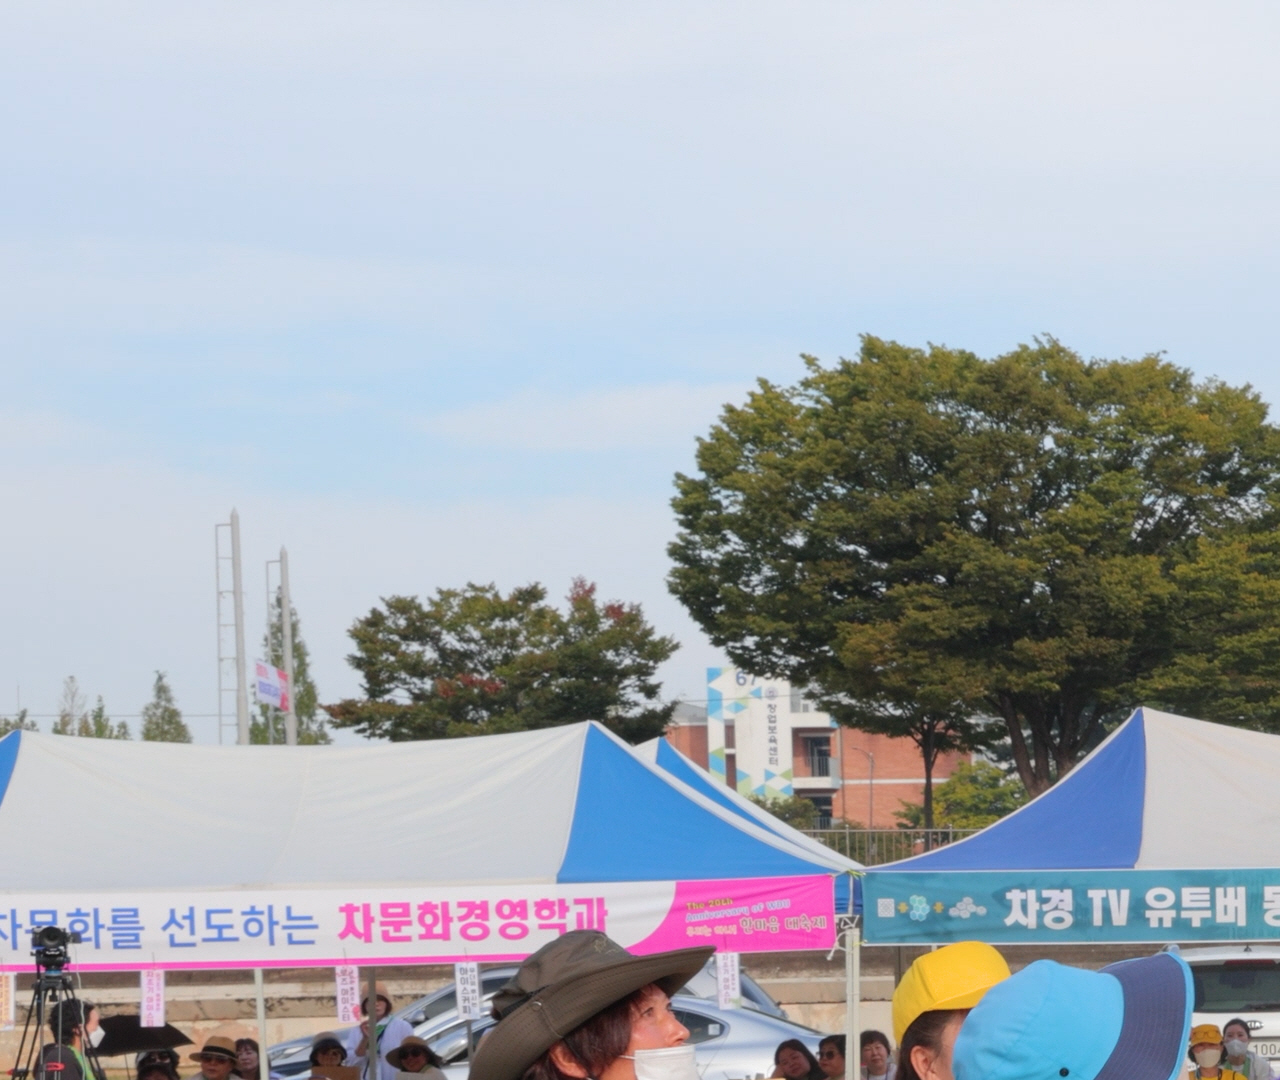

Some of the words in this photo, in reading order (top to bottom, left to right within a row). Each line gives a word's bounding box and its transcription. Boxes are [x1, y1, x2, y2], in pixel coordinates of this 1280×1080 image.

[767, 704, 779, 767] 창업보육센터
[685, 906, 749, 923] Anniversary
[751, 903, 764, 913] of
[686, 902, 705, 911] The
[708, 898, 733, 908] 20th
[1004, 888, 1074, 931] 차경
[1087, 888, 1131, 927] TV
[1145, 887, 1247, 930] 유투버
[161, 905, 319, 948] 선도하는
[338, 897, 609, 944] 차문화경영학과
[740, 917, 780, 934] 한마음
[785, 914, 827, 932] 대축제
